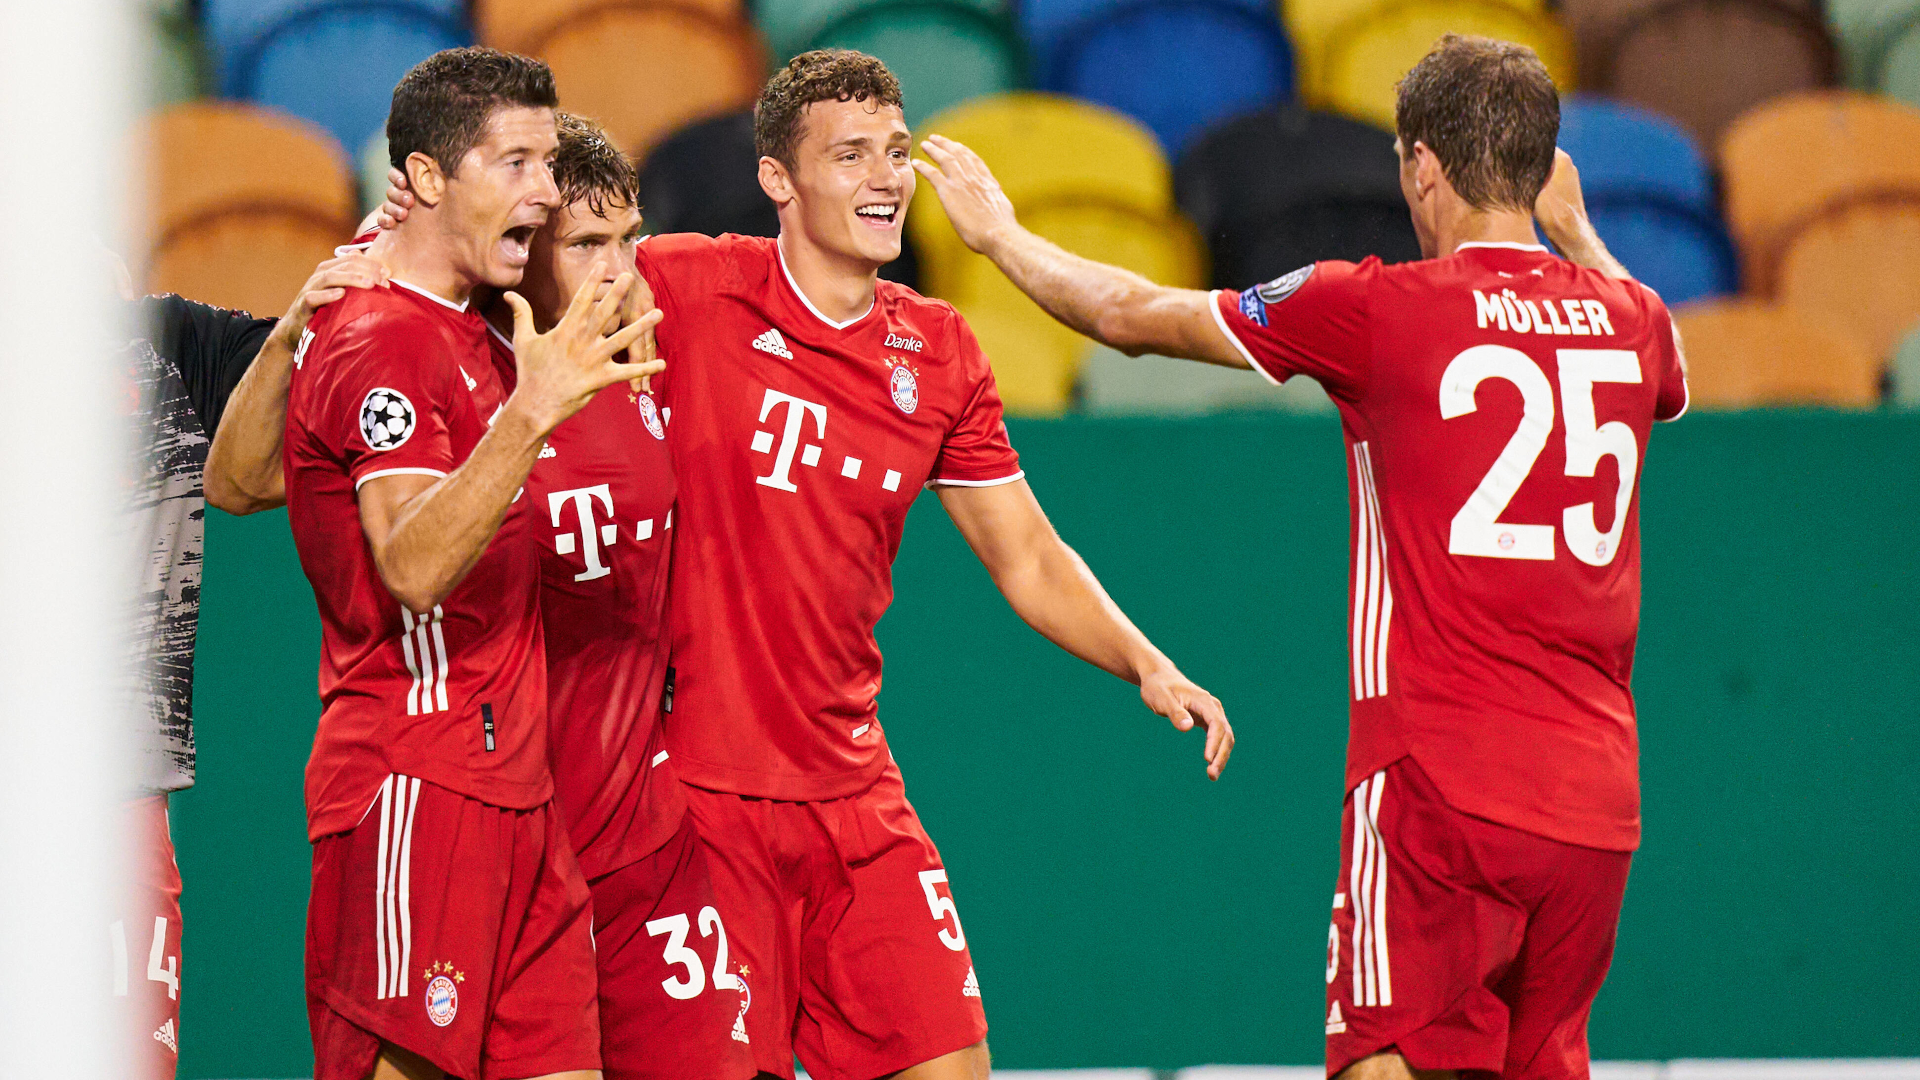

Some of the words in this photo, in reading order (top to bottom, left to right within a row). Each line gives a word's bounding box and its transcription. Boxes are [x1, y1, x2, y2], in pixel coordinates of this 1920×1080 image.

[752, 338, 794, 360] adidas
[883, 333, 923, 352] Danke
[1472, 288, 1615, 336] MÜLLER
[1439, 344, 1643, 567] 25
[917, 868, 966, 951] 5
[109, 916, 178, 1000] 14
[645, 905, 739, 1000] 32
